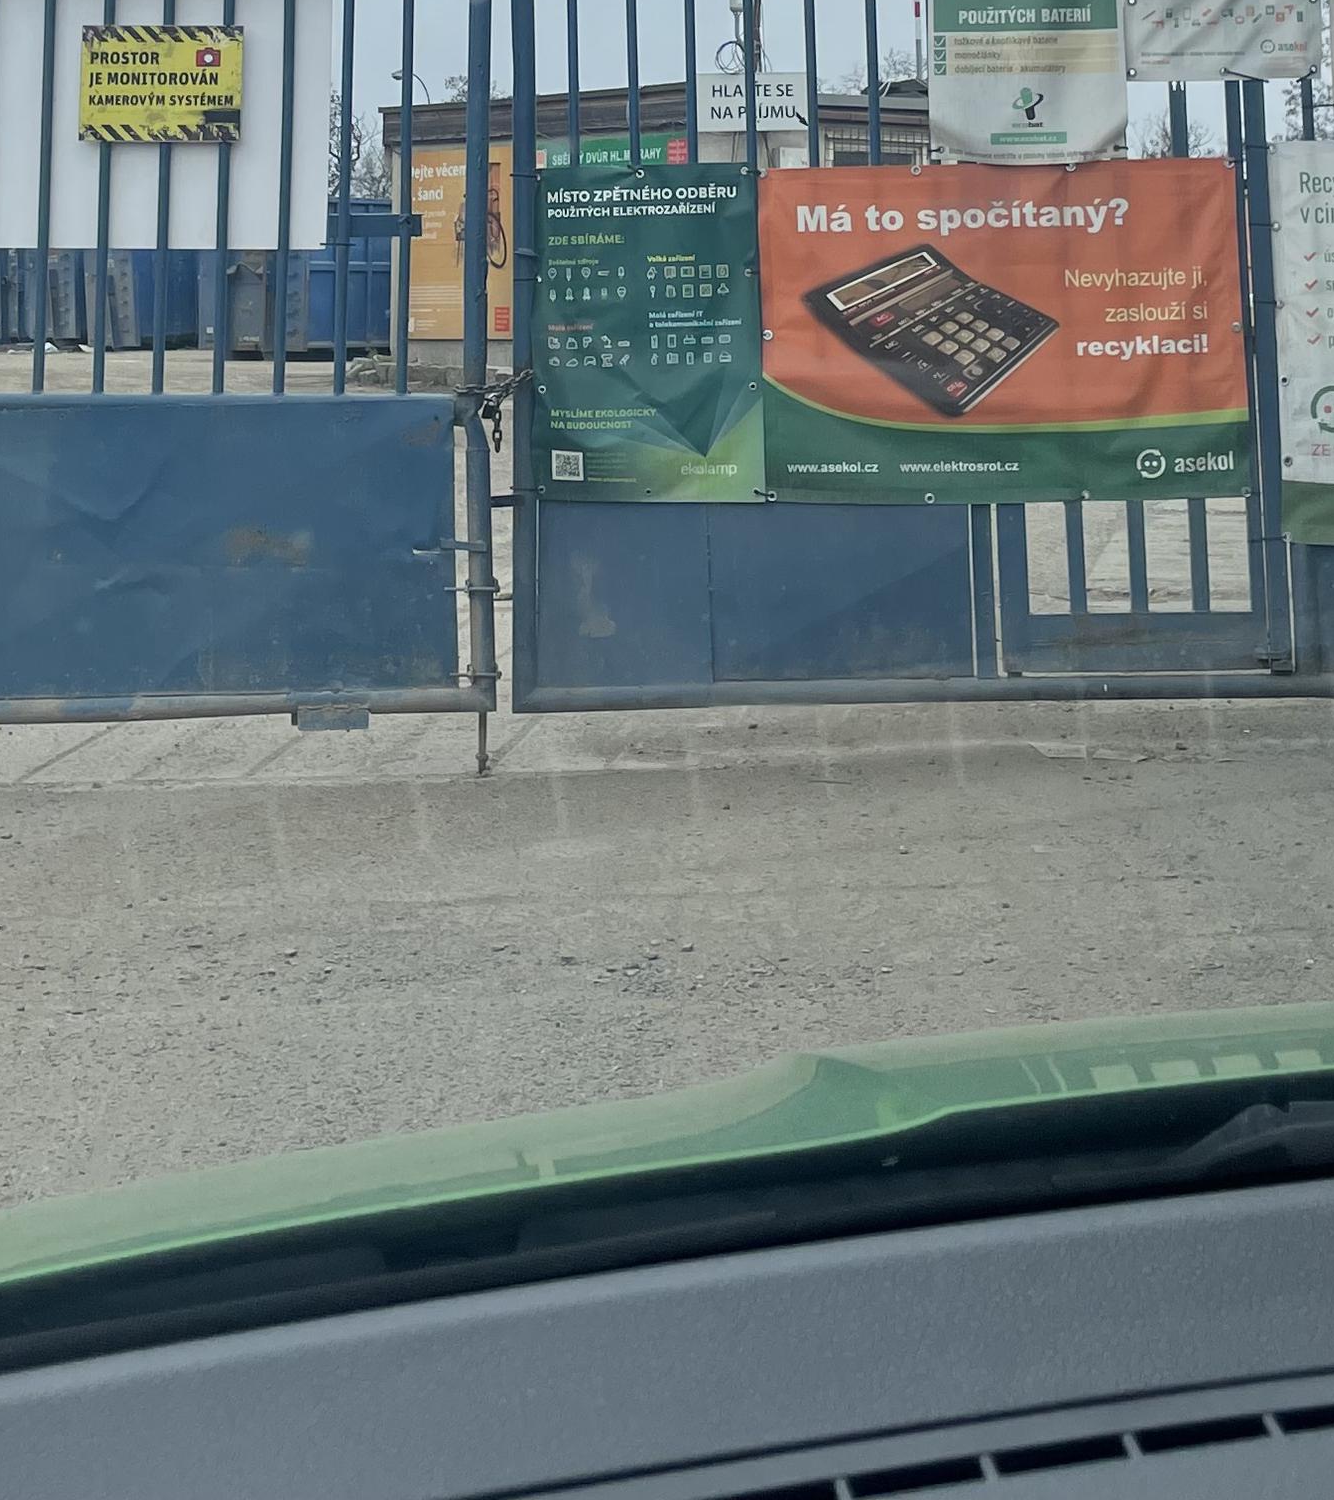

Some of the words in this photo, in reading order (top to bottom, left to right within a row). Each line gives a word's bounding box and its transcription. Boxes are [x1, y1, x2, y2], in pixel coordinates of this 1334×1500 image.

[959, 5, 1036, 24] POUŽITÝCH
[1042, 4, 1091, 23] BATERIÍ
[90, 52, 160, 65] PROSTOR
[89, 73, 102, 87] JE
[107, 69, 218, 86] MONITOROVÁN
[712, 84, 771, 97] HLATE
[776, 84, 794, 97] SE
[89, 92, 165, 106] KAMEROVÝM
[169, 92, 233, 106] SYSTÉMEM
[710, 106, 733, 119] NA
[738, 103, 796, 119] PÍJMU
[412, 164, 434, 182] ejte
[547, 188, 590, 204] MÍSTO
[593, 185, 672, 202] ZPĚTNÉHO
[675, 183, 737, 199] ODBĚRU
[547, 205, 610, 218] POUŽITÝCH
[613, 202, 715, 216] ELEKTROZAŘÍZENÍ
[796, 203, 853, 233] Má
[864, 205, 904, 232] to
[916, 197, 1130, 237] spočítaný?
[1300, 207, 1309, 224] v
[548, 236, 568, 246] ZDE
[570, 233, 624, 245] SBÍRÁME:
[1064, 267, 1186, 291] Nevyhazujte
[1192, 265, 1208, 289] ji,
[1105, 301, 1186, 322] zaslouží
[1192, 301, 1208, 320] si
[1076, 333, 1209, 361] recyklaci!
[551, 408, 593, 419] MYSLÍME
[550, 420, 566, 429] NA
[1311, 444, 1331, 457] ZE
[681, 462, 738, 476] ekolamp
[787, 461, 879, 474] www.asekol.cz
[1174, 450, 1235, 473] asekol
